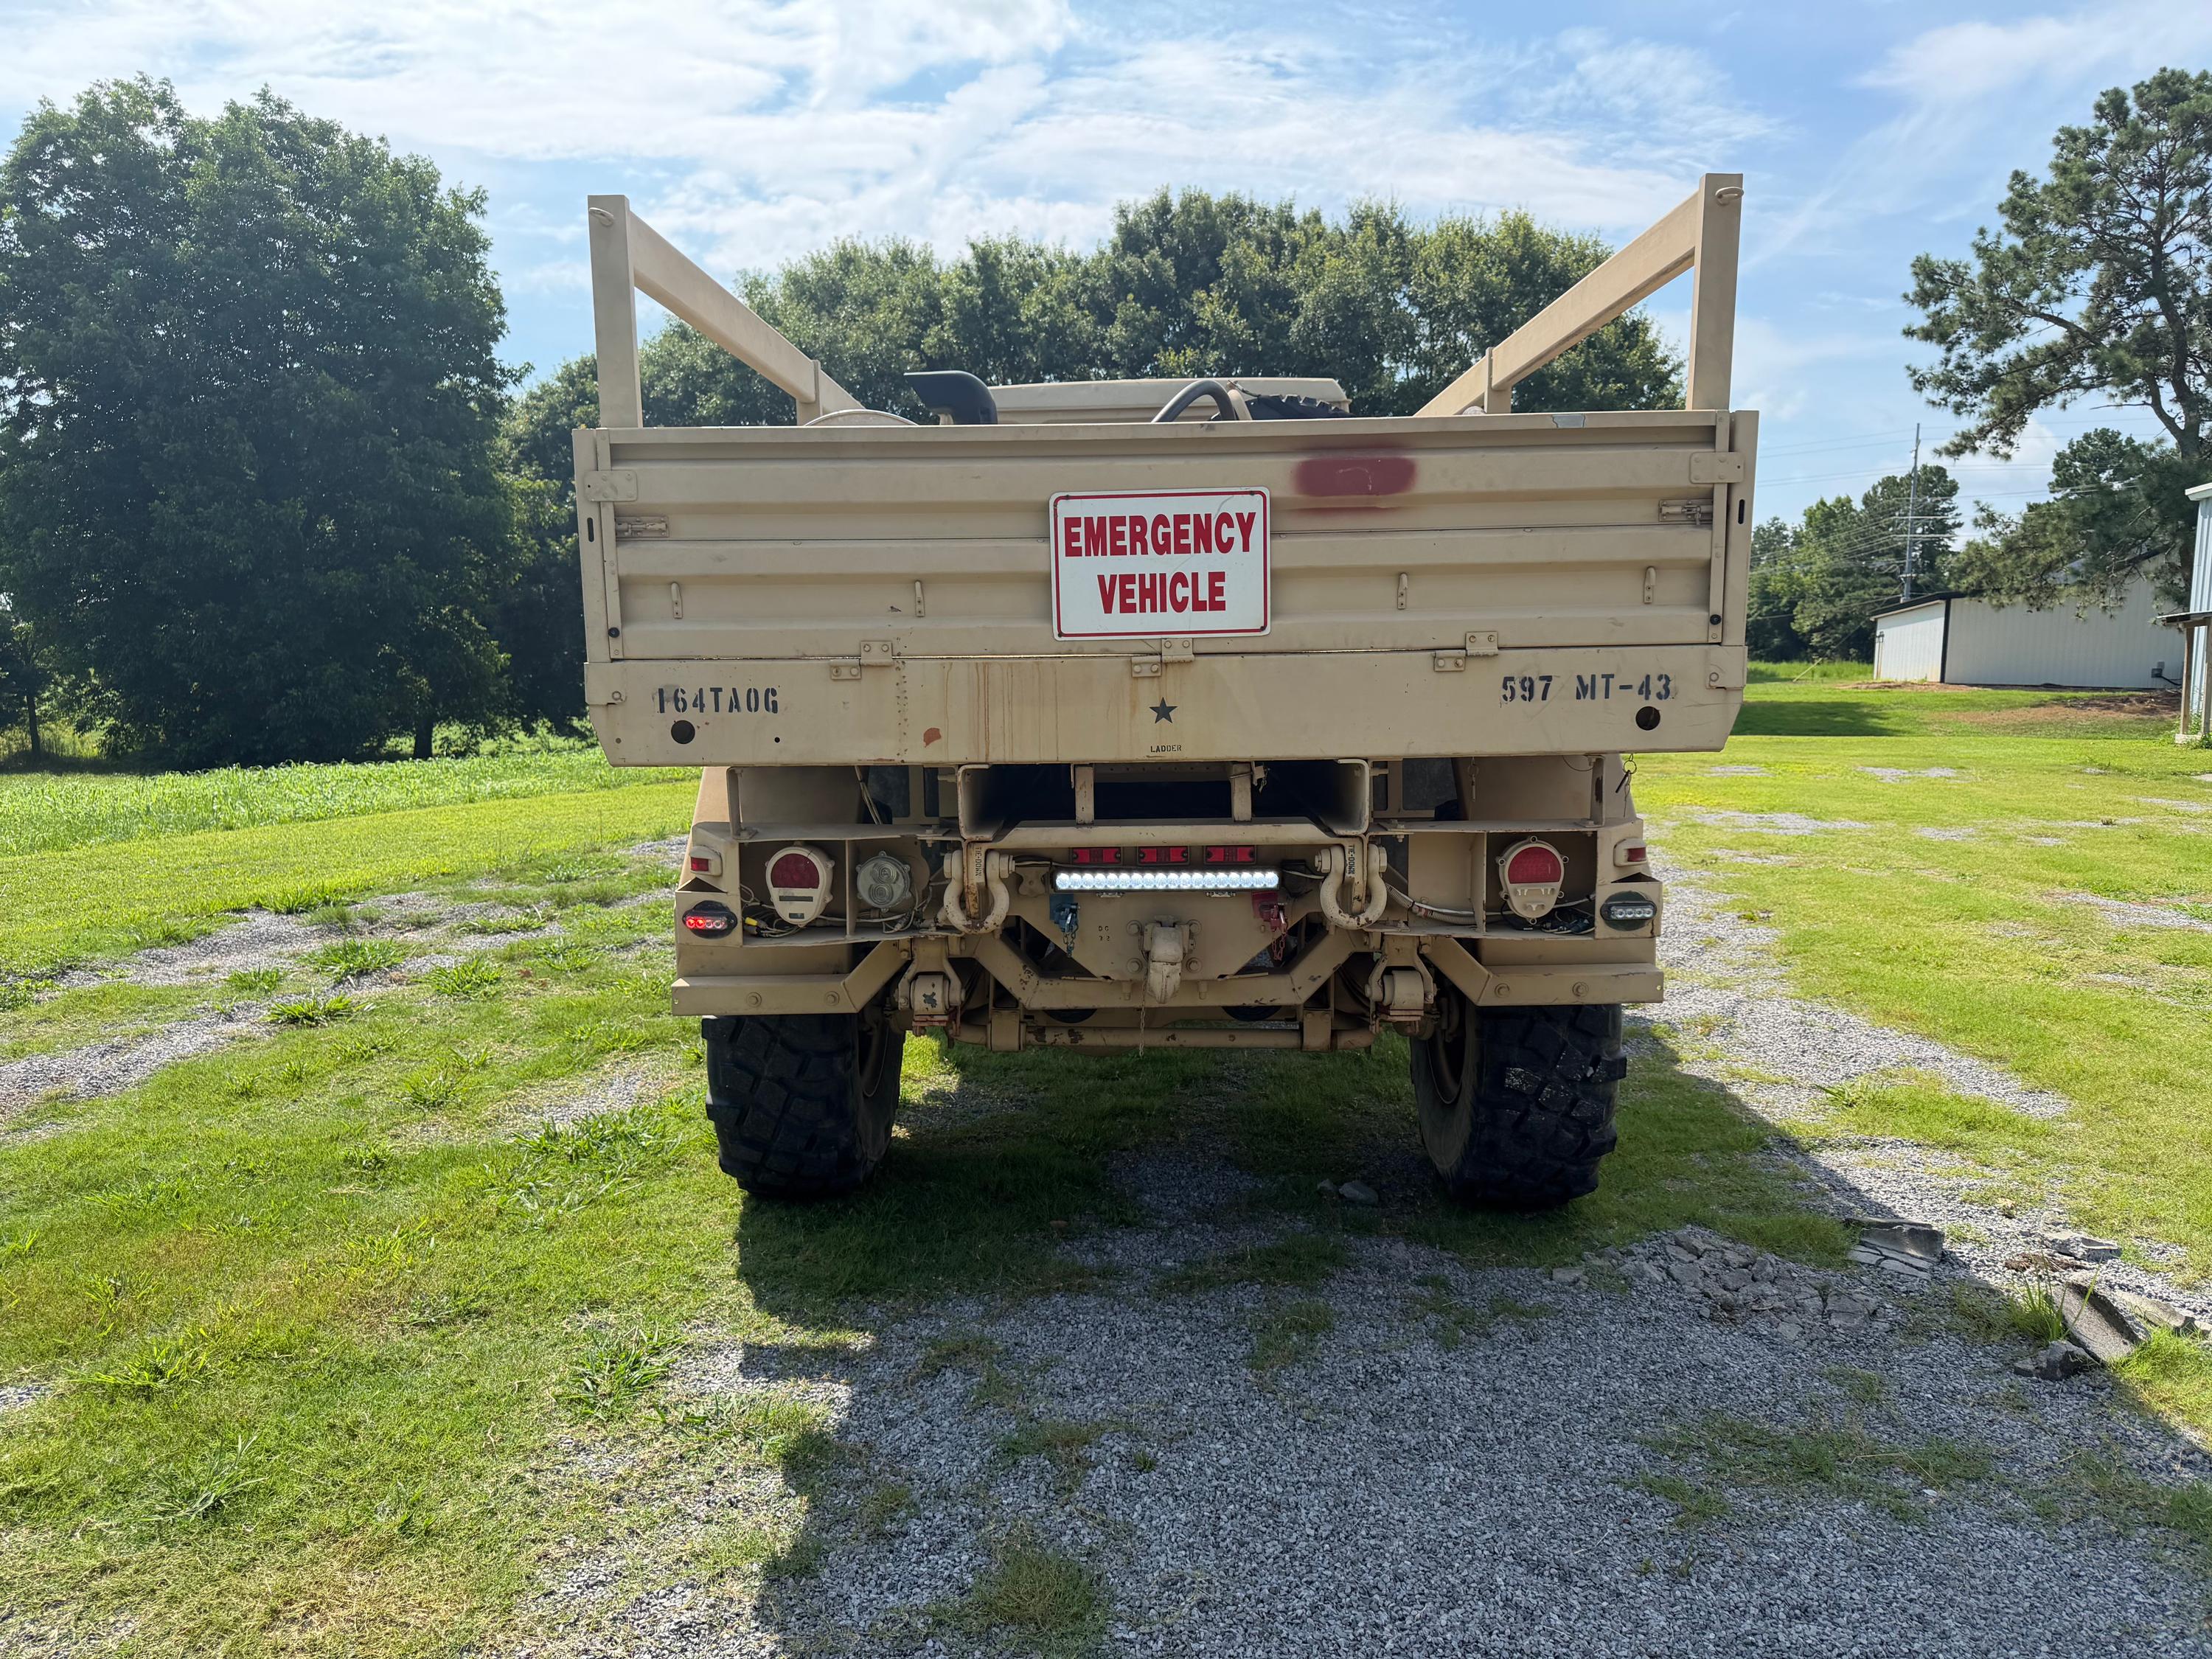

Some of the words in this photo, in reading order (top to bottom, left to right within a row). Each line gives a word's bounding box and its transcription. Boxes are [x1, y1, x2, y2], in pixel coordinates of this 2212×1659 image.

[1064, 512, 1256, 557] EMERGENCY
[1097, 571, 1225, 613] VEHICLE
[1502, 675, 1553, 702] 597
[1576, 673, 1671, 700] MT-43
[1150, 745, 1181, 753] LADDER
